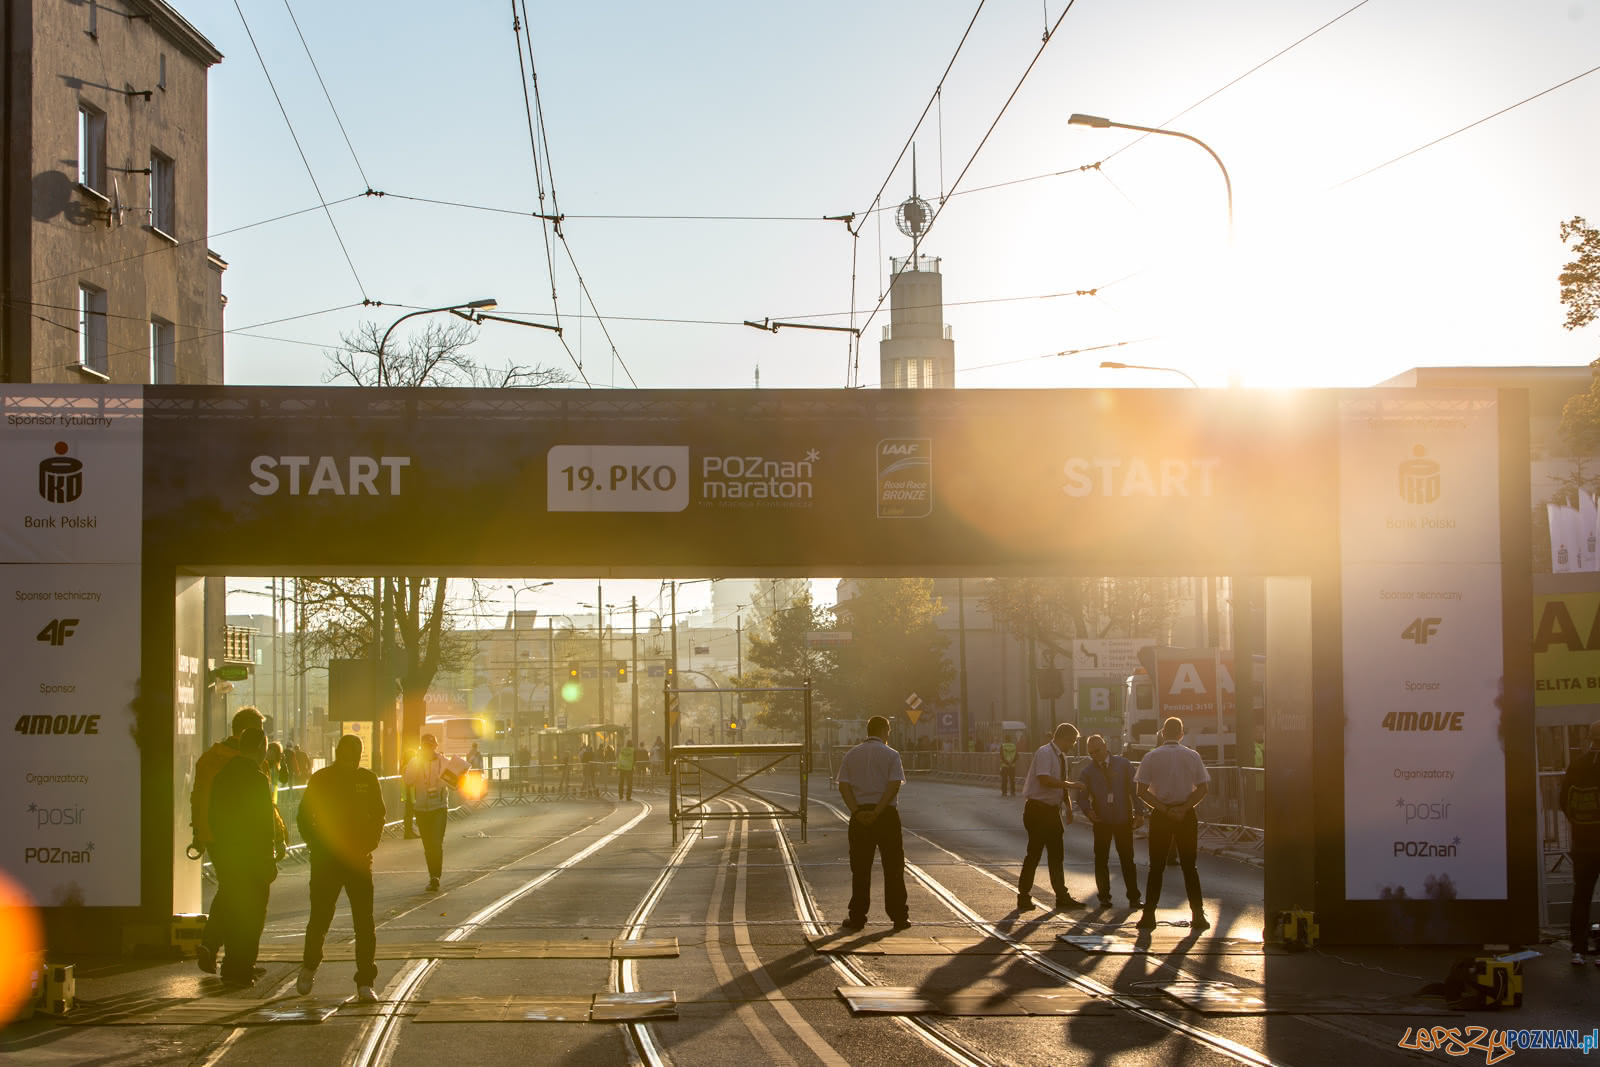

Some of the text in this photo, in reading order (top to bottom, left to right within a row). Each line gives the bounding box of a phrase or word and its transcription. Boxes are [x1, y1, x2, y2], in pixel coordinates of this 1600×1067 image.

[8, 415, 113, 428] Sponsor tytularny
[882, 444, 919, 455] IAAF
[249, 455, 411, 496] START
[609, 465, 677, 492] PKO
[1063, 456, 1221, 497] START
[703, 478, 813, 499] maraton
[24, 516, 97, 528] Bank Polski
[1386, 516, 1456, 529] Bank Polski
[15, 590, 101, 604] Sponsor techniczny
[1380, 590, 1414, 603] Sponsor
[36, 618, 80, 646] 4F
[1401, 617, 1442, 644] 4F
[1169, 663, 1208, 694] A
[1535, 676, 1600, 691] ELITA B
[39, 683, 76, 695] Sponsor
[1405, 680, 1440, 692] Sponsor
[1089, 687, 1110, 711] B
[942, 714, 953, 726] C
[26, 773, 89, 786] Organizatorzy
[1394, 769, 1455, 781] Organizatorzy
